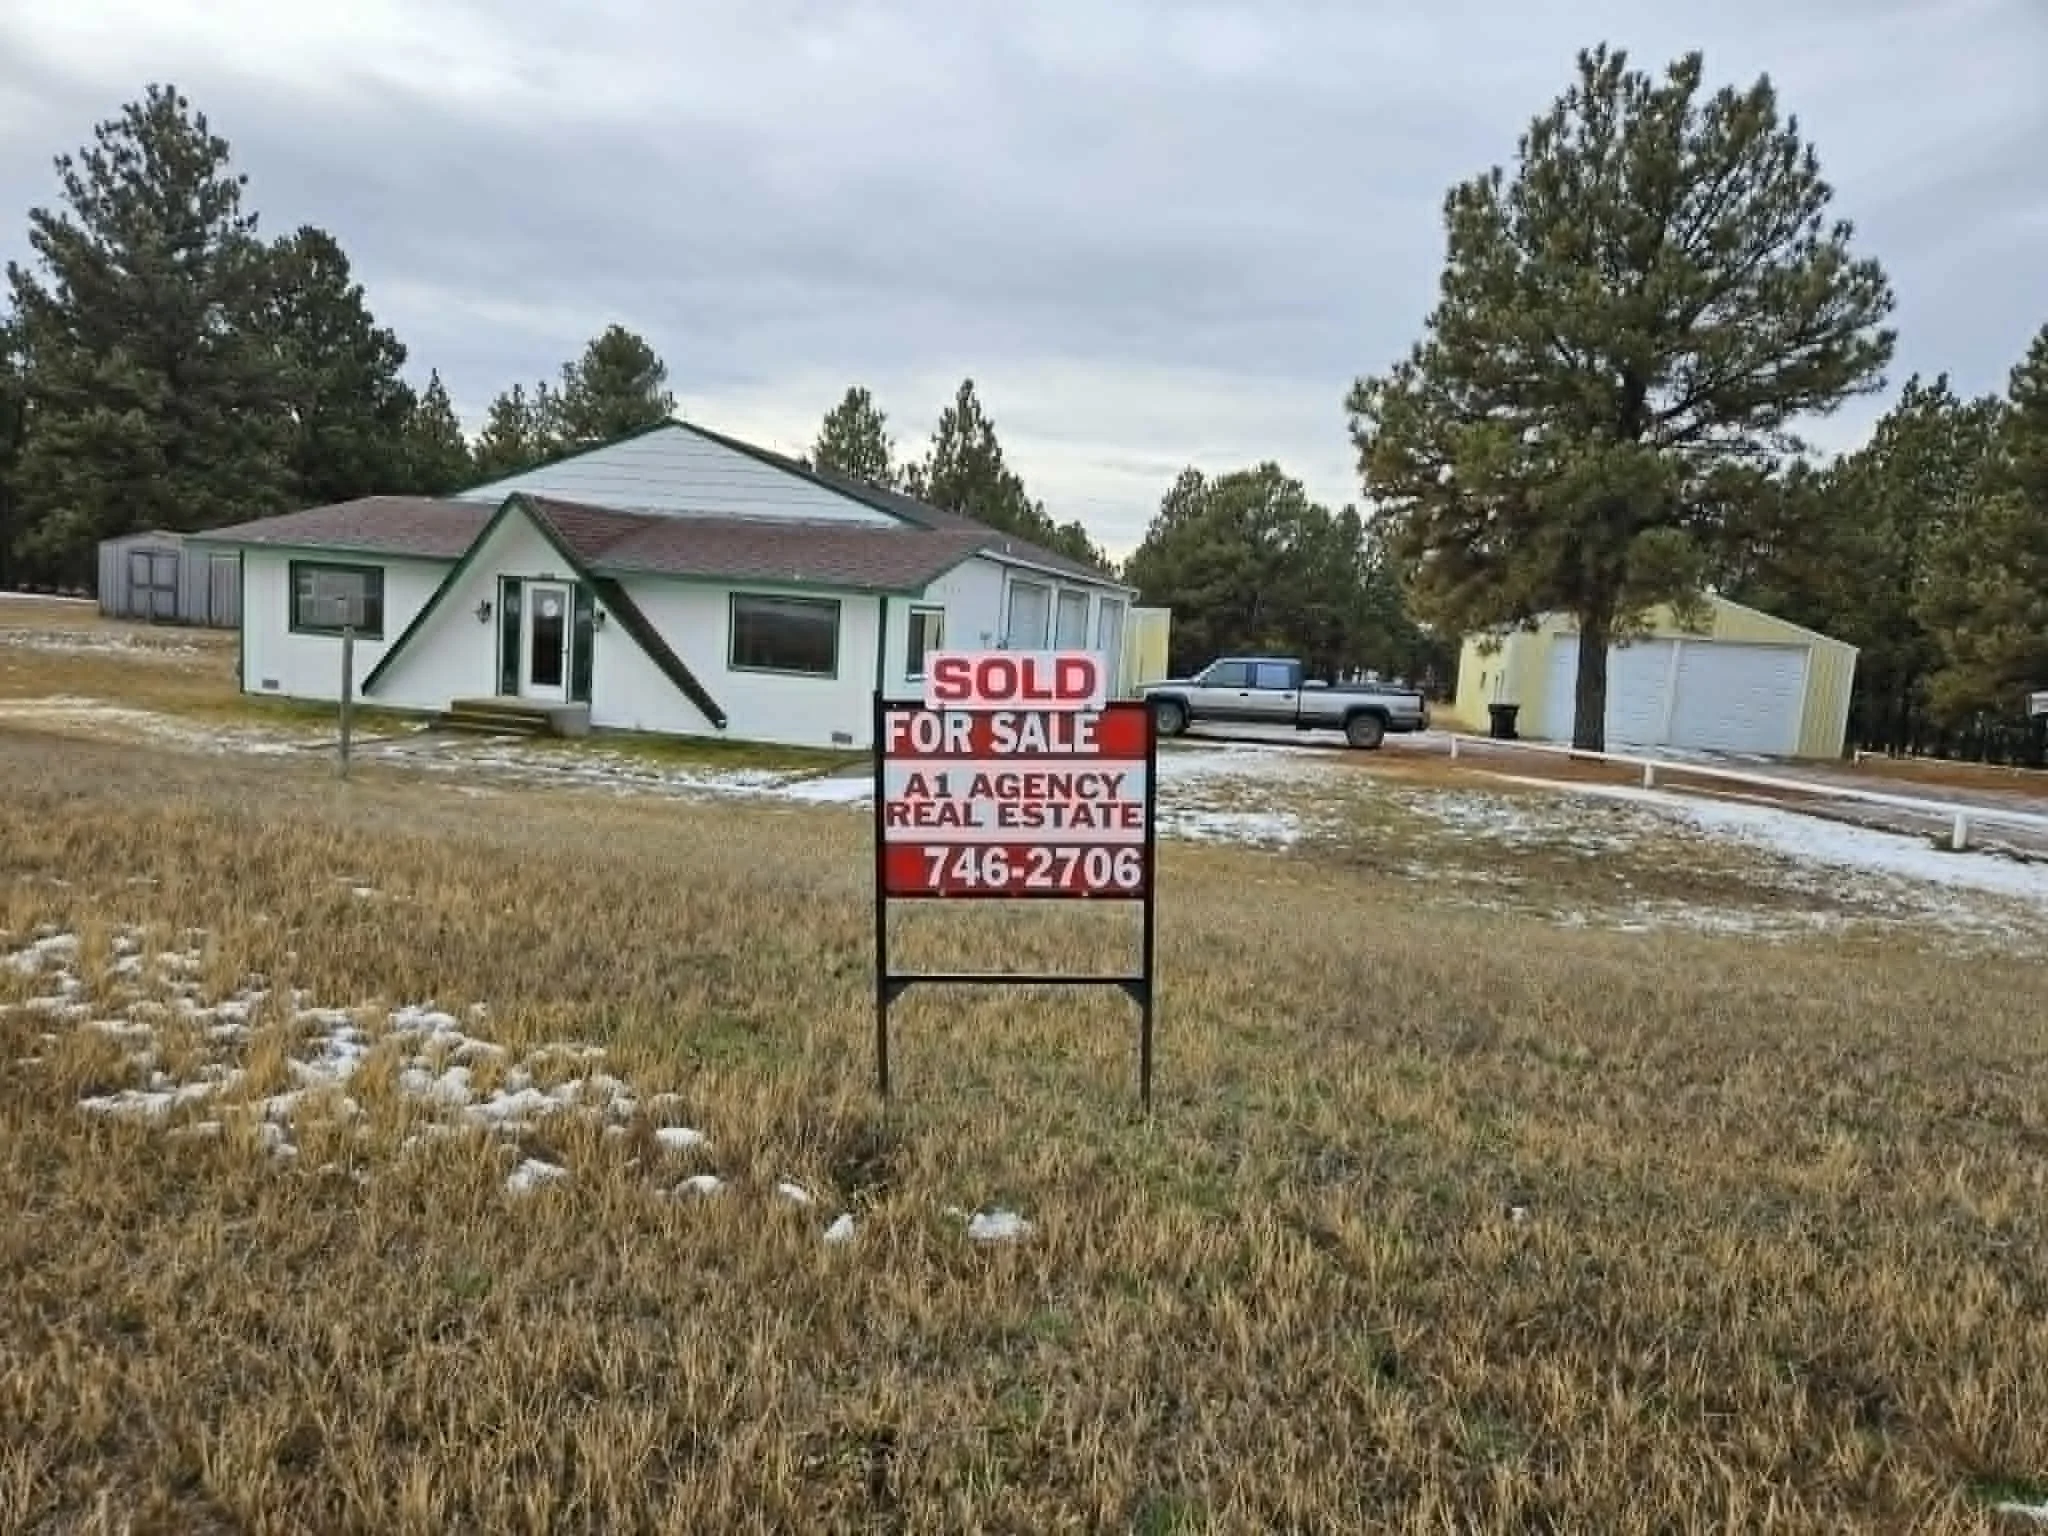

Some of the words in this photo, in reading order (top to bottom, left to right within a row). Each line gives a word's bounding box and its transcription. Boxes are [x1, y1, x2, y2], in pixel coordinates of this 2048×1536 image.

[934, 658, 1096, 700] SOLD
[885, 712, 972, 752] FOR
[991, 712, 1099, 752] SALE
[904, 773, 952, 798] A1
[968, 773, 1126, 798] AGENCY
[886, 802, 983, 827] REAL
[998, 802, 1143, 828] ESTATE
[924, 848, 1141, 887] 746-2706
